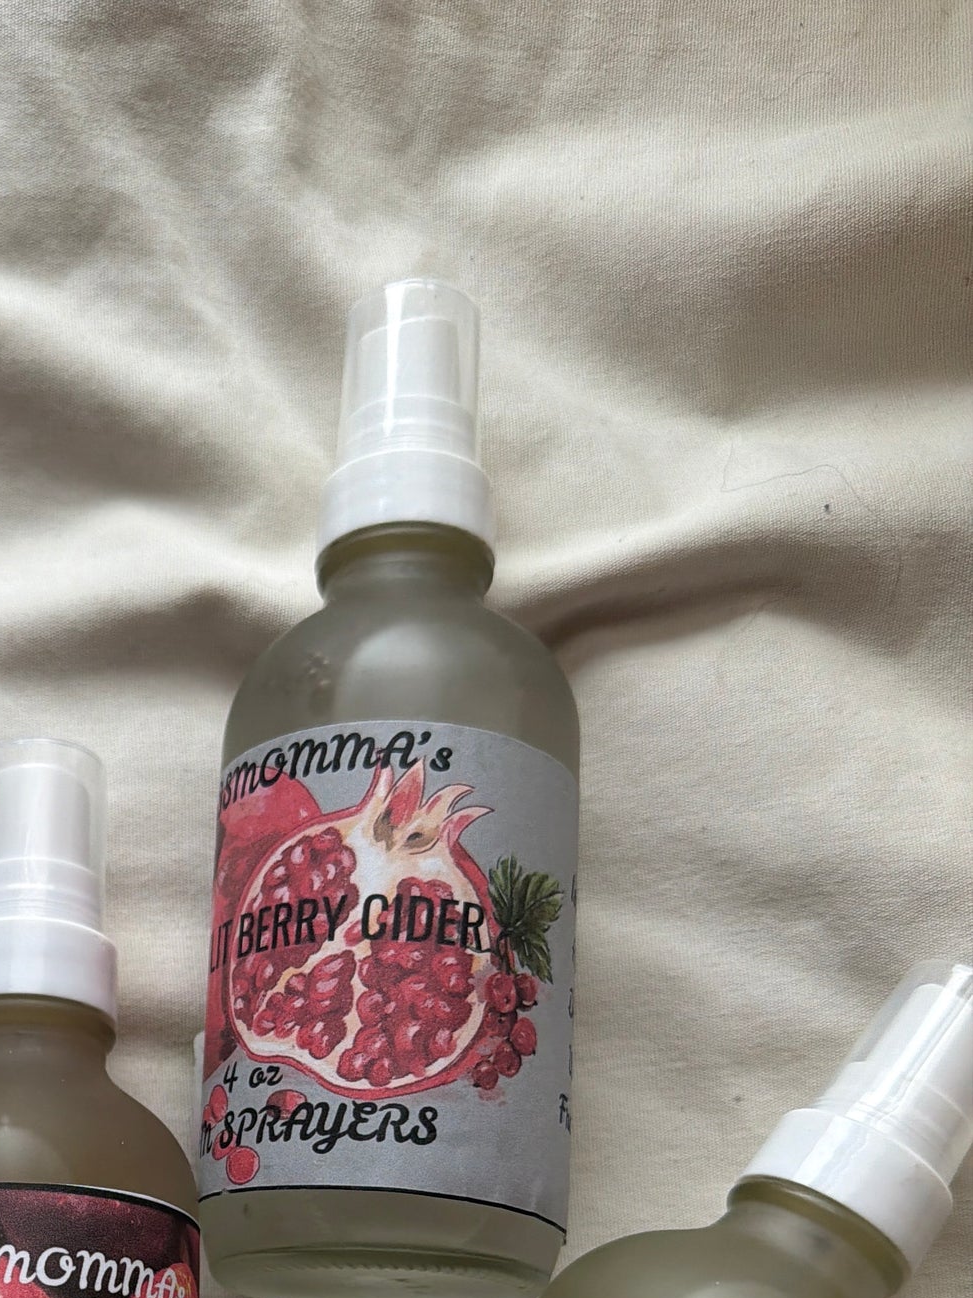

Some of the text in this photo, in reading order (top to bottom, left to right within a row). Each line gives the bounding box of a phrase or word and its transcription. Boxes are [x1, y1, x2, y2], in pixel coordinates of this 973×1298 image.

[220, 730, 454, 812] SMOMMA's
[237, 894, 347, 959] BERRY
[360, 894, 491, 953] CIDER
[223, 1060, 284, 1093] 4 oz
[219, 1100, 439, 1154] SPRAYERS
